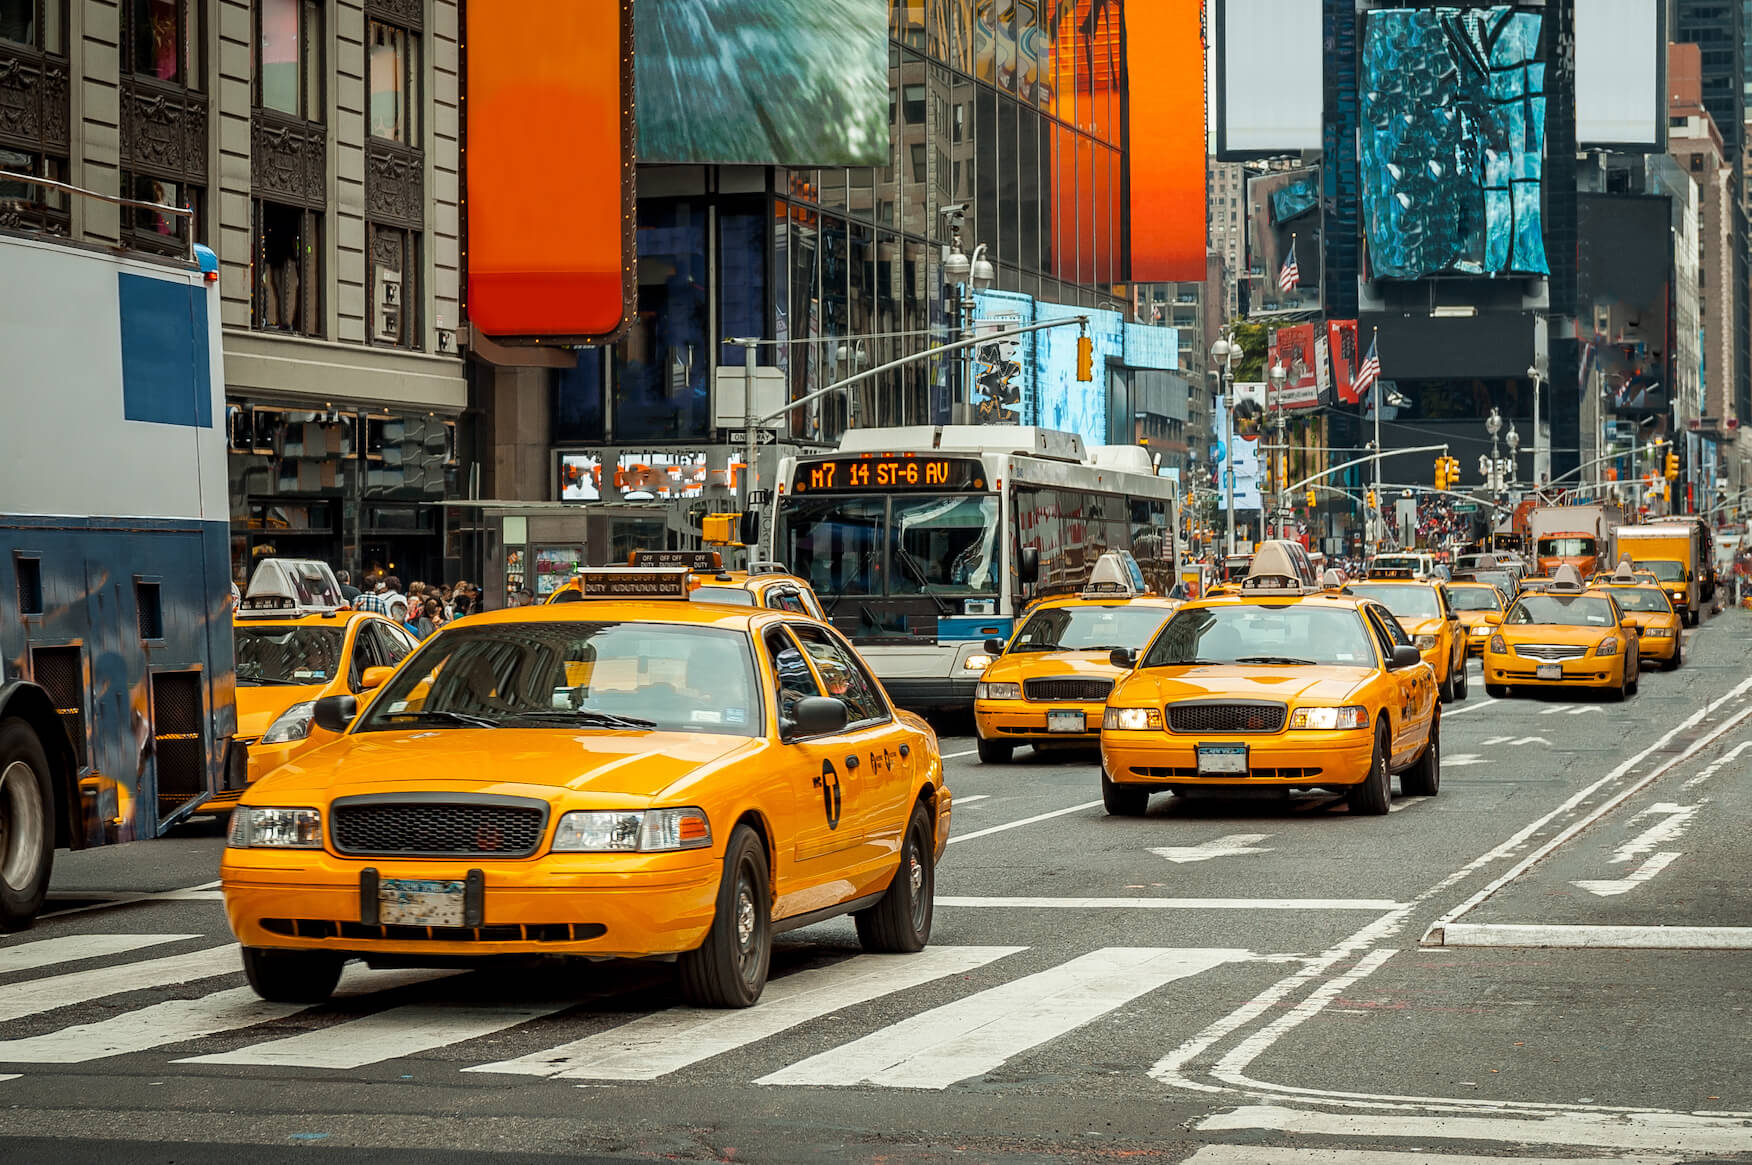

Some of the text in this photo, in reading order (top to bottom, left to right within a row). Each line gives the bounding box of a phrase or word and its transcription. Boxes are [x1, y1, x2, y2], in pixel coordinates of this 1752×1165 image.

[811, 461, 949, 488] M7 14 ST-6 AV
[586, 584, 605, 592] DUTY
[660, 584, 680, 592] DUTY
